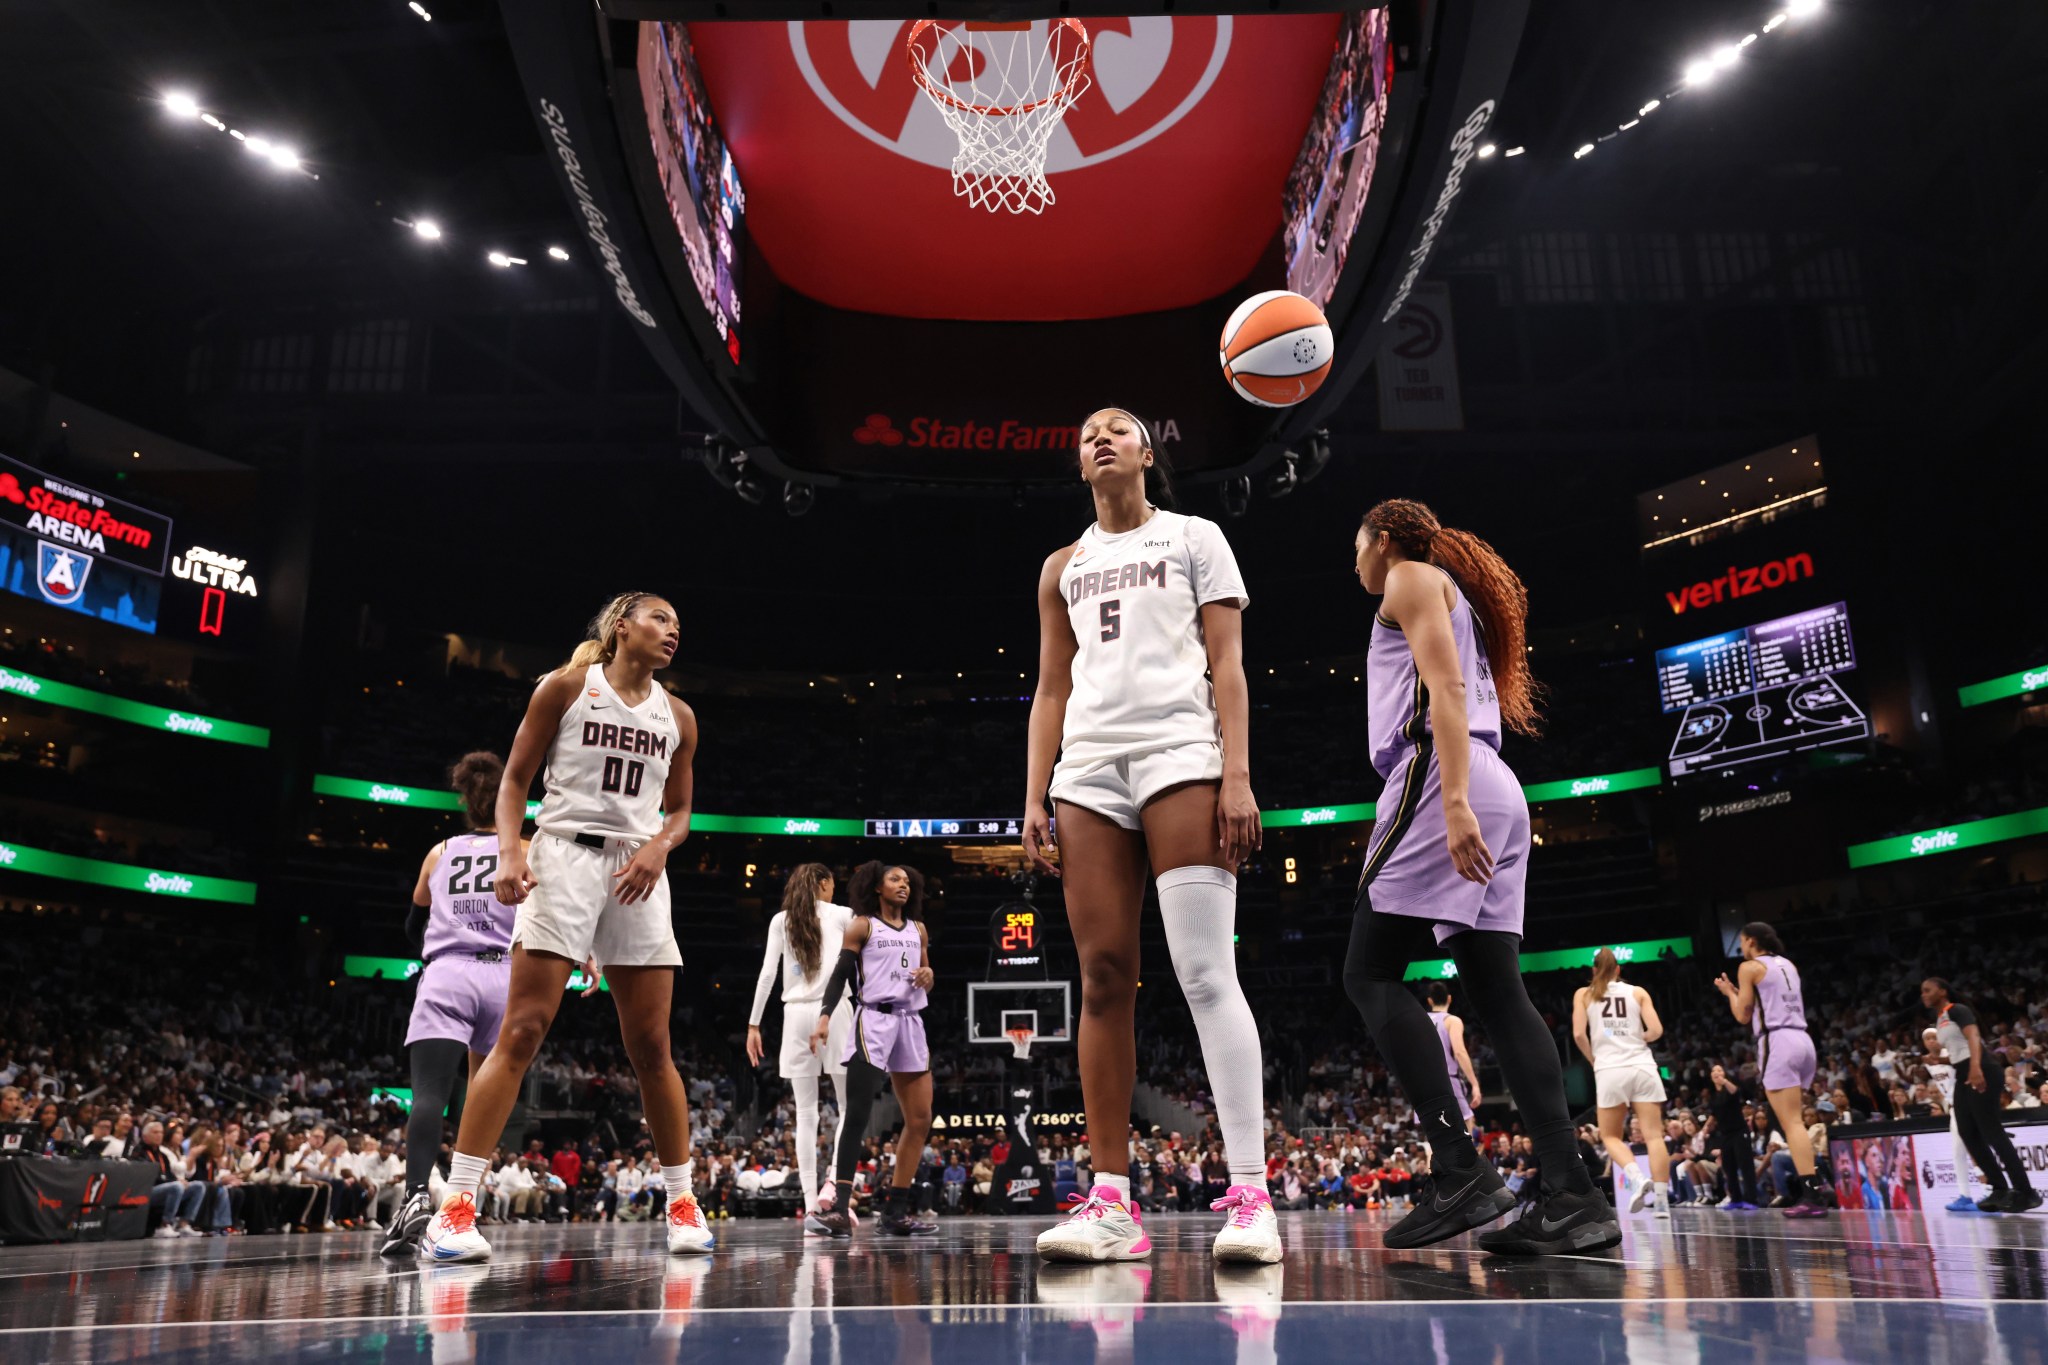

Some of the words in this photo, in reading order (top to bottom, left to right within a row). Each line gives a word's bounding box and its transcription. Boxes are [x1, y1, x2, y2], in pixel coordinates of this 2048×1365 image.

[44, 479, 90, 504] WELCOME
[91, 496, 105, 508] TO
[26, 512, 106, 553] ARENA
[1143, 540, 1171, 548] Albert
[172, 556, 257, 597] ULTRA
[1070, 560, 1166, 608] DREAM
[1666, 552, 1814, 614] verizon
[1099, 599, 1120, 643] 5
[165, 713, 213, 734] Sprite
[582, 720, 667, 760] DREAM
[601, 755, 645, 797] 00
[1570, 776, 1610, 796] Sprite
[368, 784, 409, 803] Sprite
[784, 819, 820, 834] Sprite
[1301, 808, 1337, 825] Sprite
[941, 822, 960, 834] 20
[978, 822, 999, 833] 5:49
[1909, 830, 1959, 854] Sprite
[145, 873, 193, 893] Sprite
[448, 855, 498, 895] 22
[453, 899, 489, 915] BURTON
[467, 921, 495, 931] AT&T
[1006, 913, 1034, 927] 5:49
[877, 940, 904, 949] GOLDEN
[1001, 927, 1033, 950] 24
[901, 951, 909, 968] 6
[1008, 956, 1040, 965] TISSOT
[1600, 997, 1627, 1018] 20
[1013, 1088, 1031, 1099] ally
[950, 1114, 1007, 1127] DELTA
